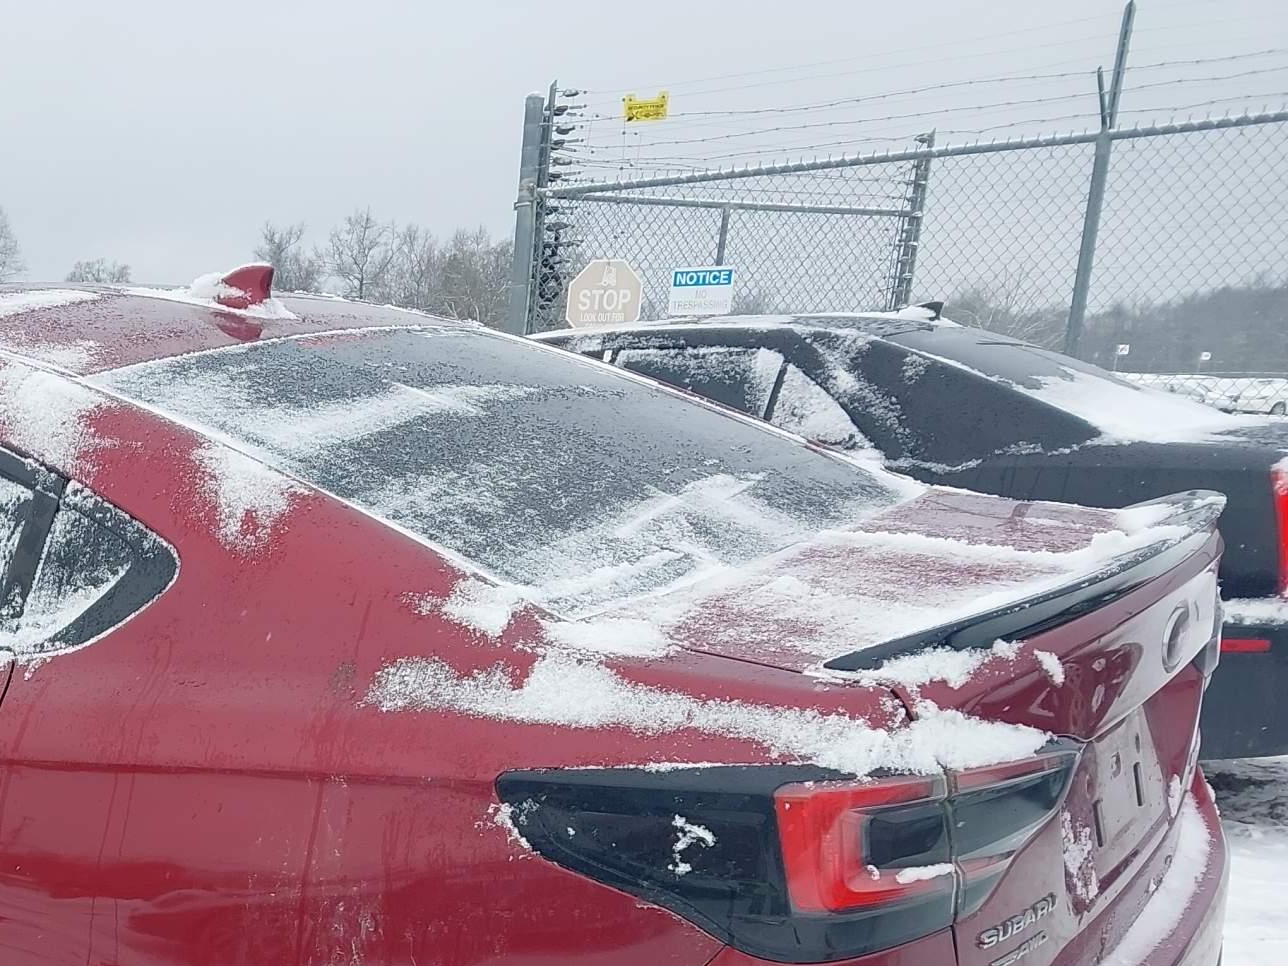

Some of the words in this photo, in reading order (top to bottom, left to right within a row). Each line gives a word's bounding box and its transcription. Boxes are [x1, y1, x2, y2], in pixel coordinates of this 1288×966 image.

[675, 271, 729, 286] NOTICE
[578, 289, 632, 312] STOP
[696, 289, 707, 297] NO
[581, 312, 596, 322] LOOK
[597, 312, 611, 322] OUT
[612, 312, 625, 321] FOR
[975, 892, 1058, 951] SUBARU
